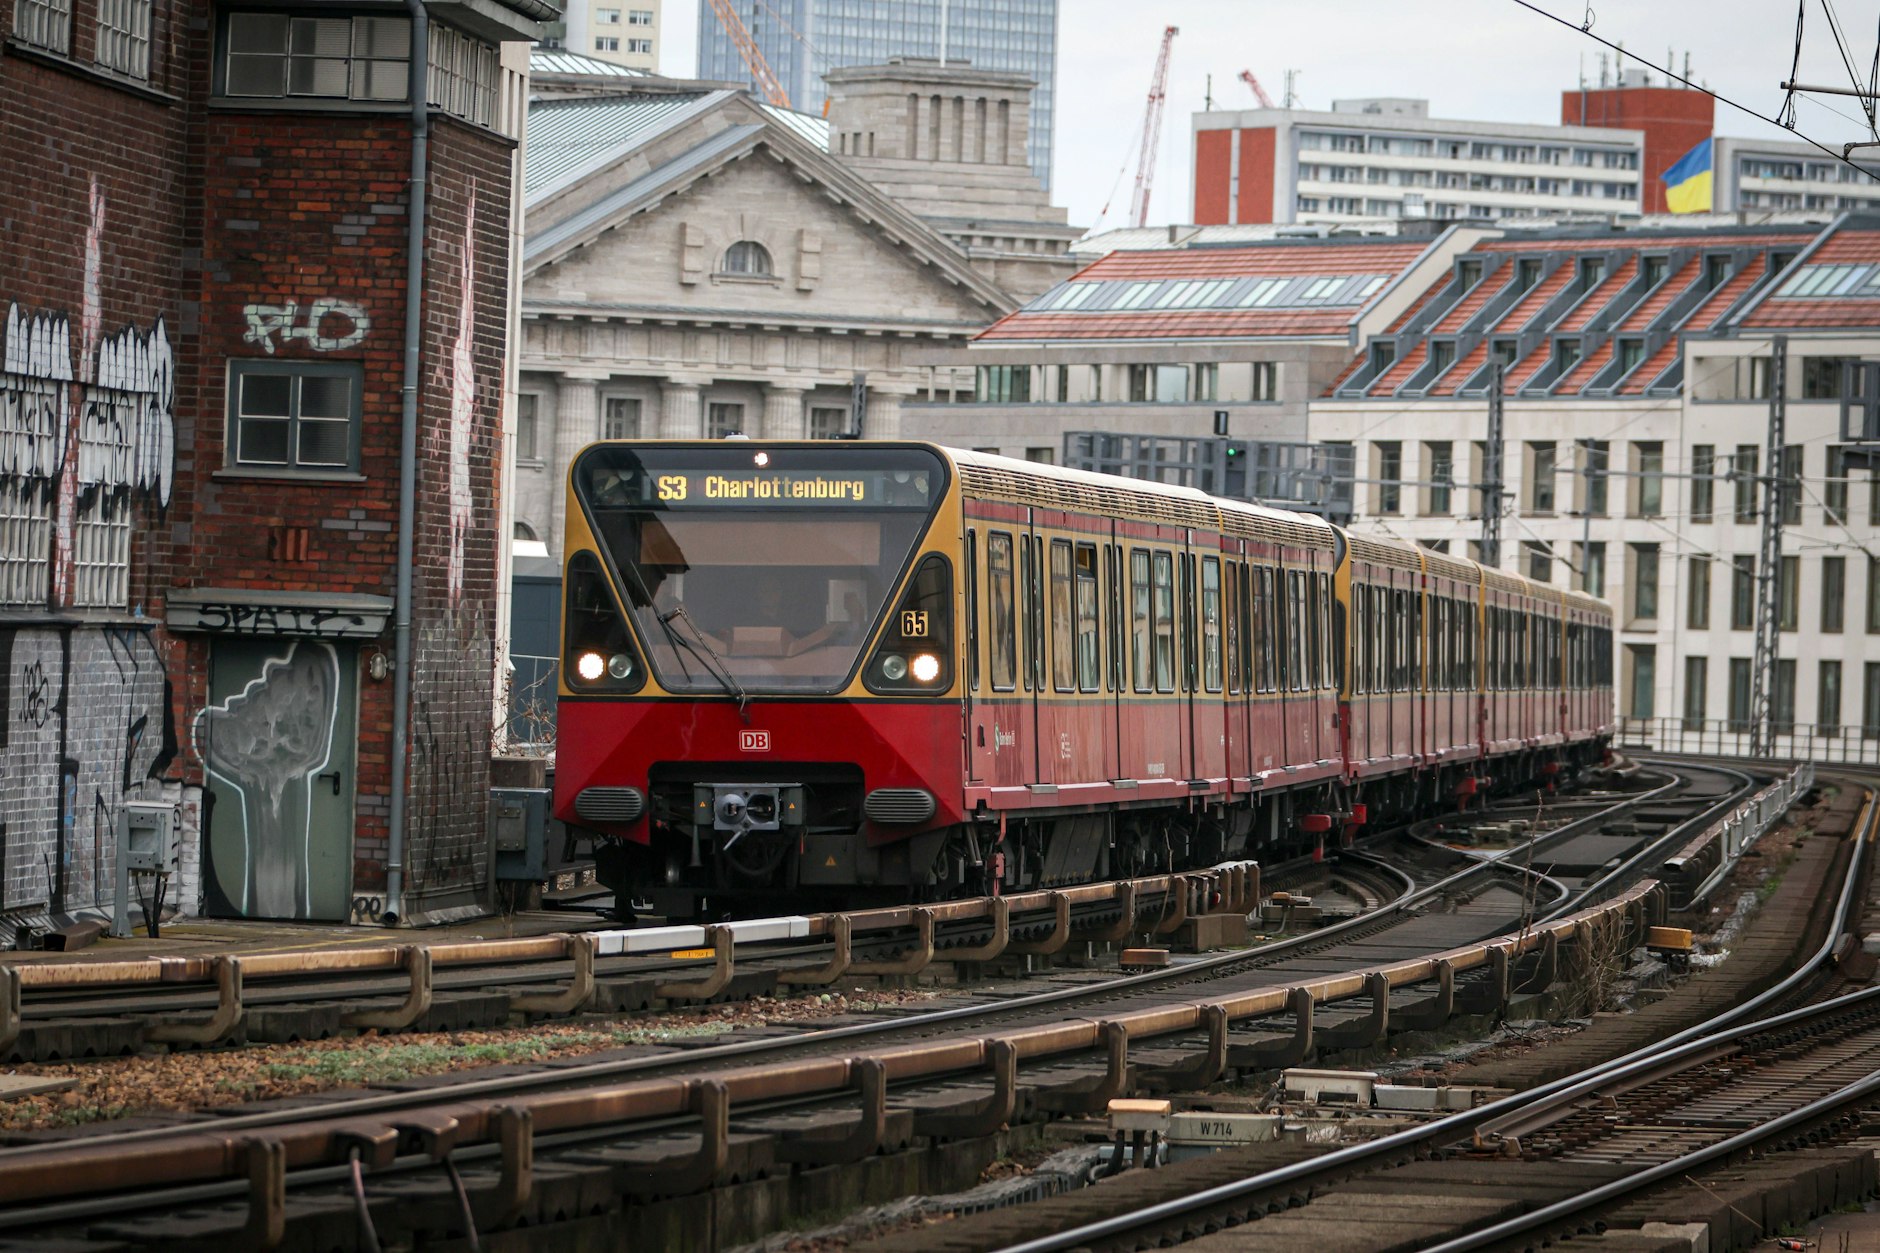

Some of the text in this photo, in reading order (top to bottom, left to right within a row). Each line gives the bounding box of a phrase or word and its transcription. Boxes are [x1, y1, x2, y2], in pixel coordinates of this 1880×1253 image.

[658, 475, 864, 500] S3 Charlottenburg
[903, 612, 925, 635] 65
[743, 733, 767, 749] DB
[1200, 1121, 1232, 1137] W 714
